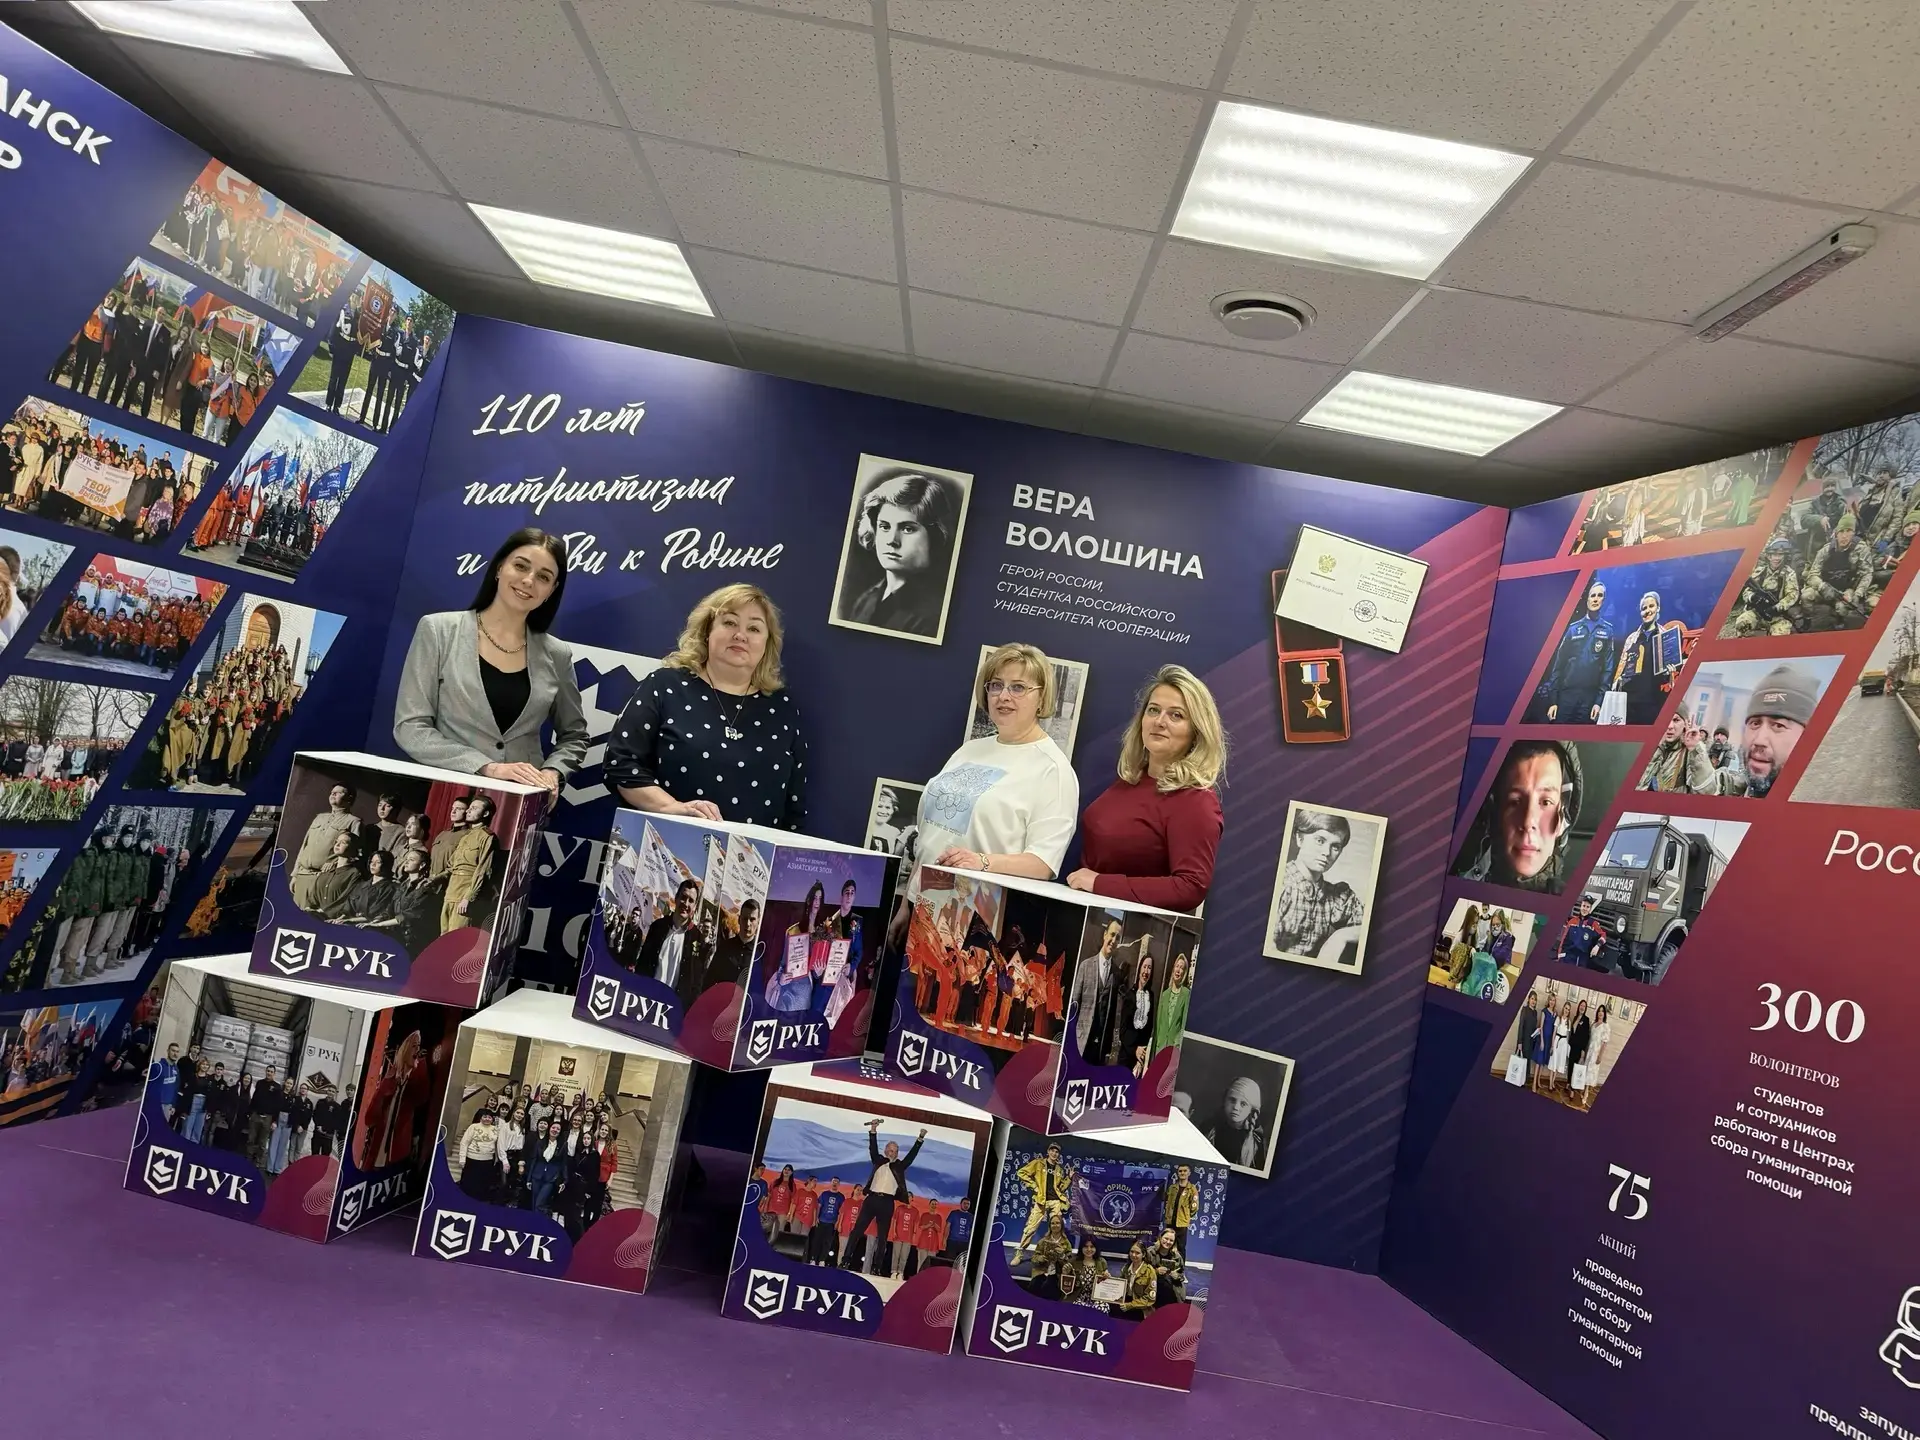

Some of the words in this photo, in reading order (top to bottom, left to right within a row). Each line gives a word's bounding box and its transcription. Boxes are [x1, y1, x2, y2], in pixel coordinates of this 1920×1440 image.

[472, 393, 561, 436] 110
[565, 401, 646, 436] лет
[463, 466, 735, 515] патриотизма
[1012, 483, 1095, 521] ВЕРА
[456, 552, 487, 576] и
[619, 547, 645, 571] к
[660, 527, 785, 574] Родине
[1005, 521, 1204, 580] ВОЛОШИНА
[999, 563, 1045, 581] ГЕРОЙ
[1046, 571, 1105, 593] РОССИИ,
[993, 598, 1094, 627] УНИВЕРСИТЕТА
[1097, 618, 1191, 645] КООПЕРАЦИИ
[996, 580, 1072, 605] СТУДЕНТКА
[1074, 595, 1176, 623] РОССИЙСКОГО
[319, 942, 398, 979] РУК
[619, 991, 674, 1031] РУК
[1749, 982, 1866, 1044] 300
[318, 1047, 341, 1062] РУК
[777, 1022, 824, 1050] РУК
[928, 1047, 985, 1091] РУК
[1748, 1051, 1841, 1089] ВОЛОНТЕРОВ
[1088, 1083, 1131, 1112] РУК
[1753, 1084, 1825, 1117] студентов
[1735, 1101, 1745, 1113] и
[1747, 1104, 1838, 1144] сотрудников
[1714, 1113, 1779, 1147] работают
[1780, 1136, 1790, 1150] в
[1792, 1138, 1856, 1173] Центрах
[185, 1163, 254, 1205] РУК
[1709, 1132, 1750, 1160] сбора
[1751, 1149, 1853, 1196] гуманитарной
[1746, 1167, 1803, 1200] помощи
[366, 1169, 412, 1211] РУК
[1608, 1162, 1651, 1221] 75
[479, 1224, 558, 1263] РУК
[1597, 1232, 1637, 1260] АКЦИЙ
[1571, 1267, 1653, 1324] Университетом
[1585, 1257, 1644, 1297] проведено
[791, 1284, 869, 1323] РУК
[1583, 1296, 1598, 1312] по
[1599, 1304, 1633, 1334] сбору
[1036, 1319, 1111, 1356] РУК
[1568, 1307, 1643, 1360] гуманитарной
[1579, 1335, 1623, 1370] помощи
[1809, 1403, 1877, 1440] предпр
